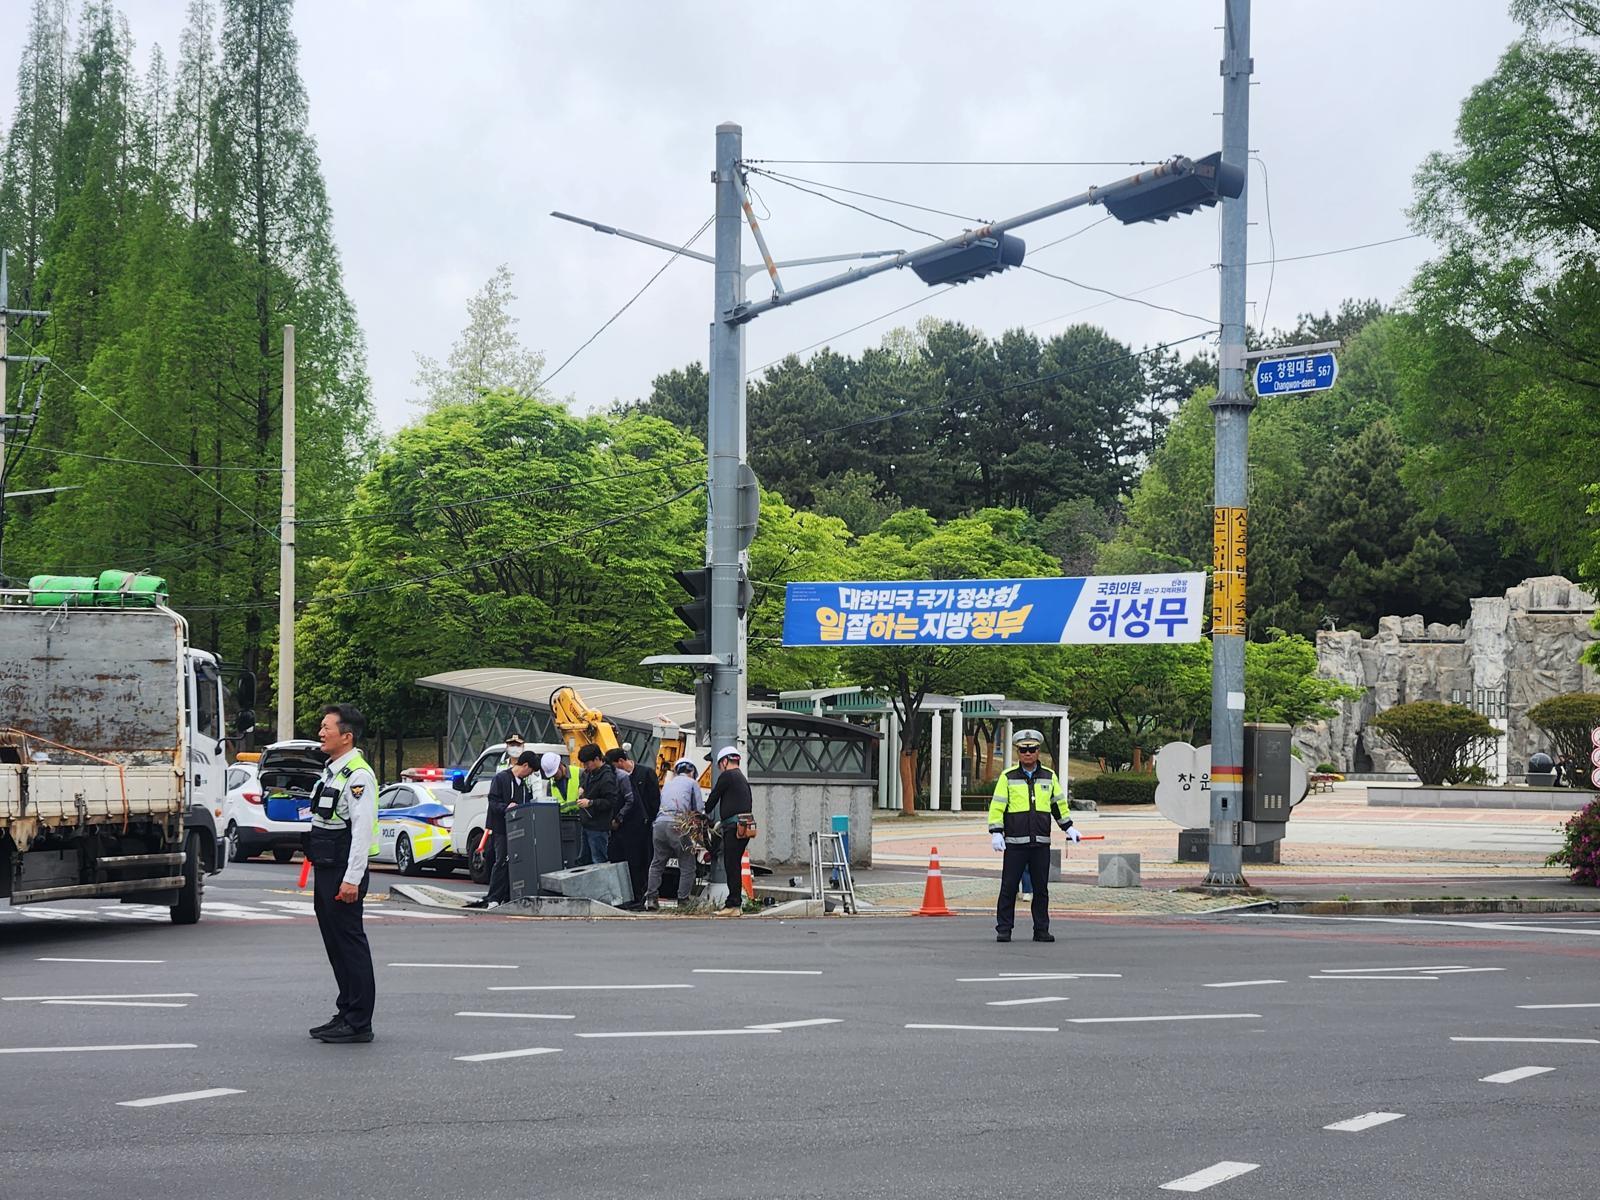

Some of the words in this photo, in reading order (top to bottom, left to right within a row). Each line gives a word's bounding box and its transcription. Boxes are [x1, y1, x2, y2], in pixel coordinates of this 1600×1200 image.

[1277, 360, 1314, 378] 창원대로
[1318, 365, 1331, 376] 567
[1260, 372, 1273, 383] 565
[1274, 378, 1316, 391] Changwon-daero
[1097, 582, 1142, 595] 국회의원
[838, 586, 914, 610] 대한민국
[916, 588, 955, 609] 국가
[956, 584, 1022, 609] 정상화
[815, 606, 919, 641] 일잘하는
[919, 604, 1034, 640] 지방정부
[1088, 598, 1189, 638] 허성무
